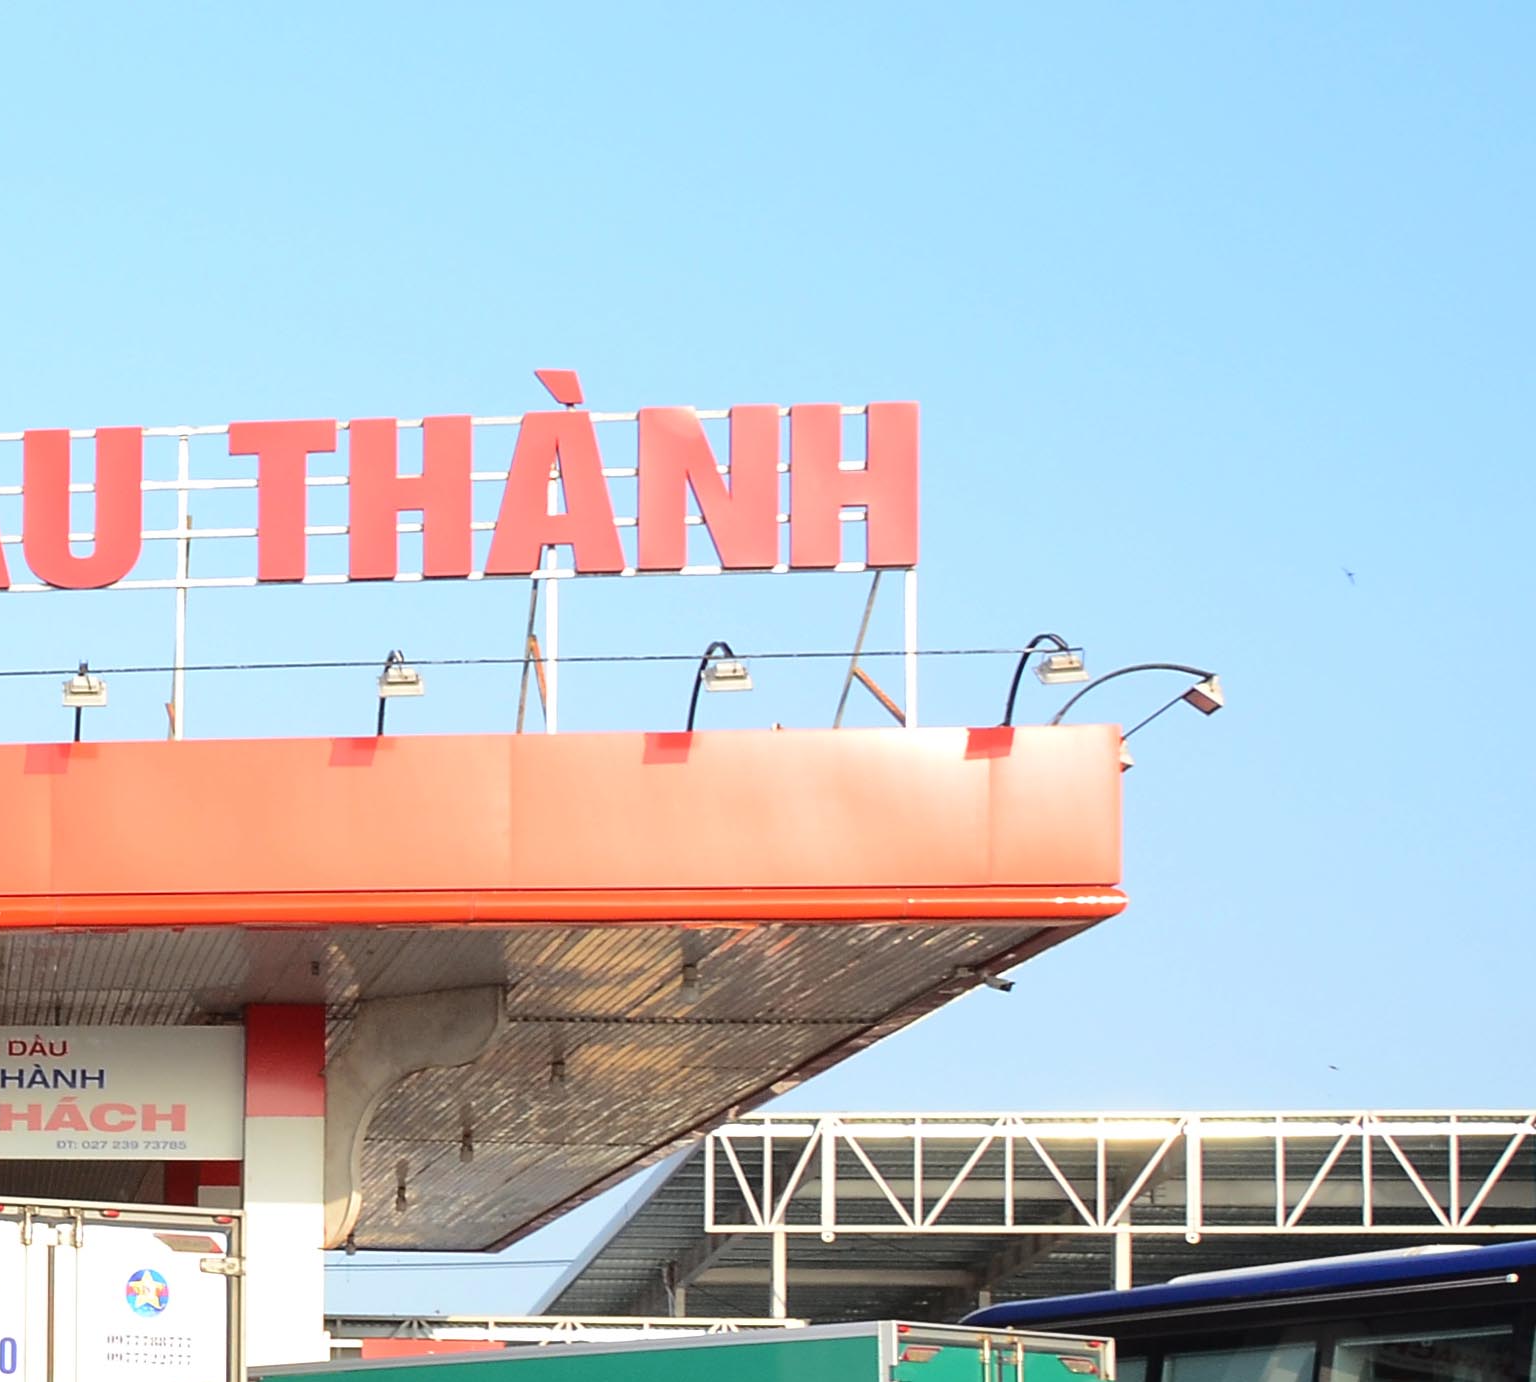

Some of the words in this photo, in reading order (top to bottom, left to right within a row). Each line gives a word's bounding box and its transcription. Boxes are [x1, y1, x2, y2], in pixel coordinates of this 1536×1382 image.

[228, 368, 920, 582] THÀNH
[8, 1034, 68, 1056] DẦU
[81, 1140, 108, 1150] 027
[112, 1140, 139, 1150] 239
